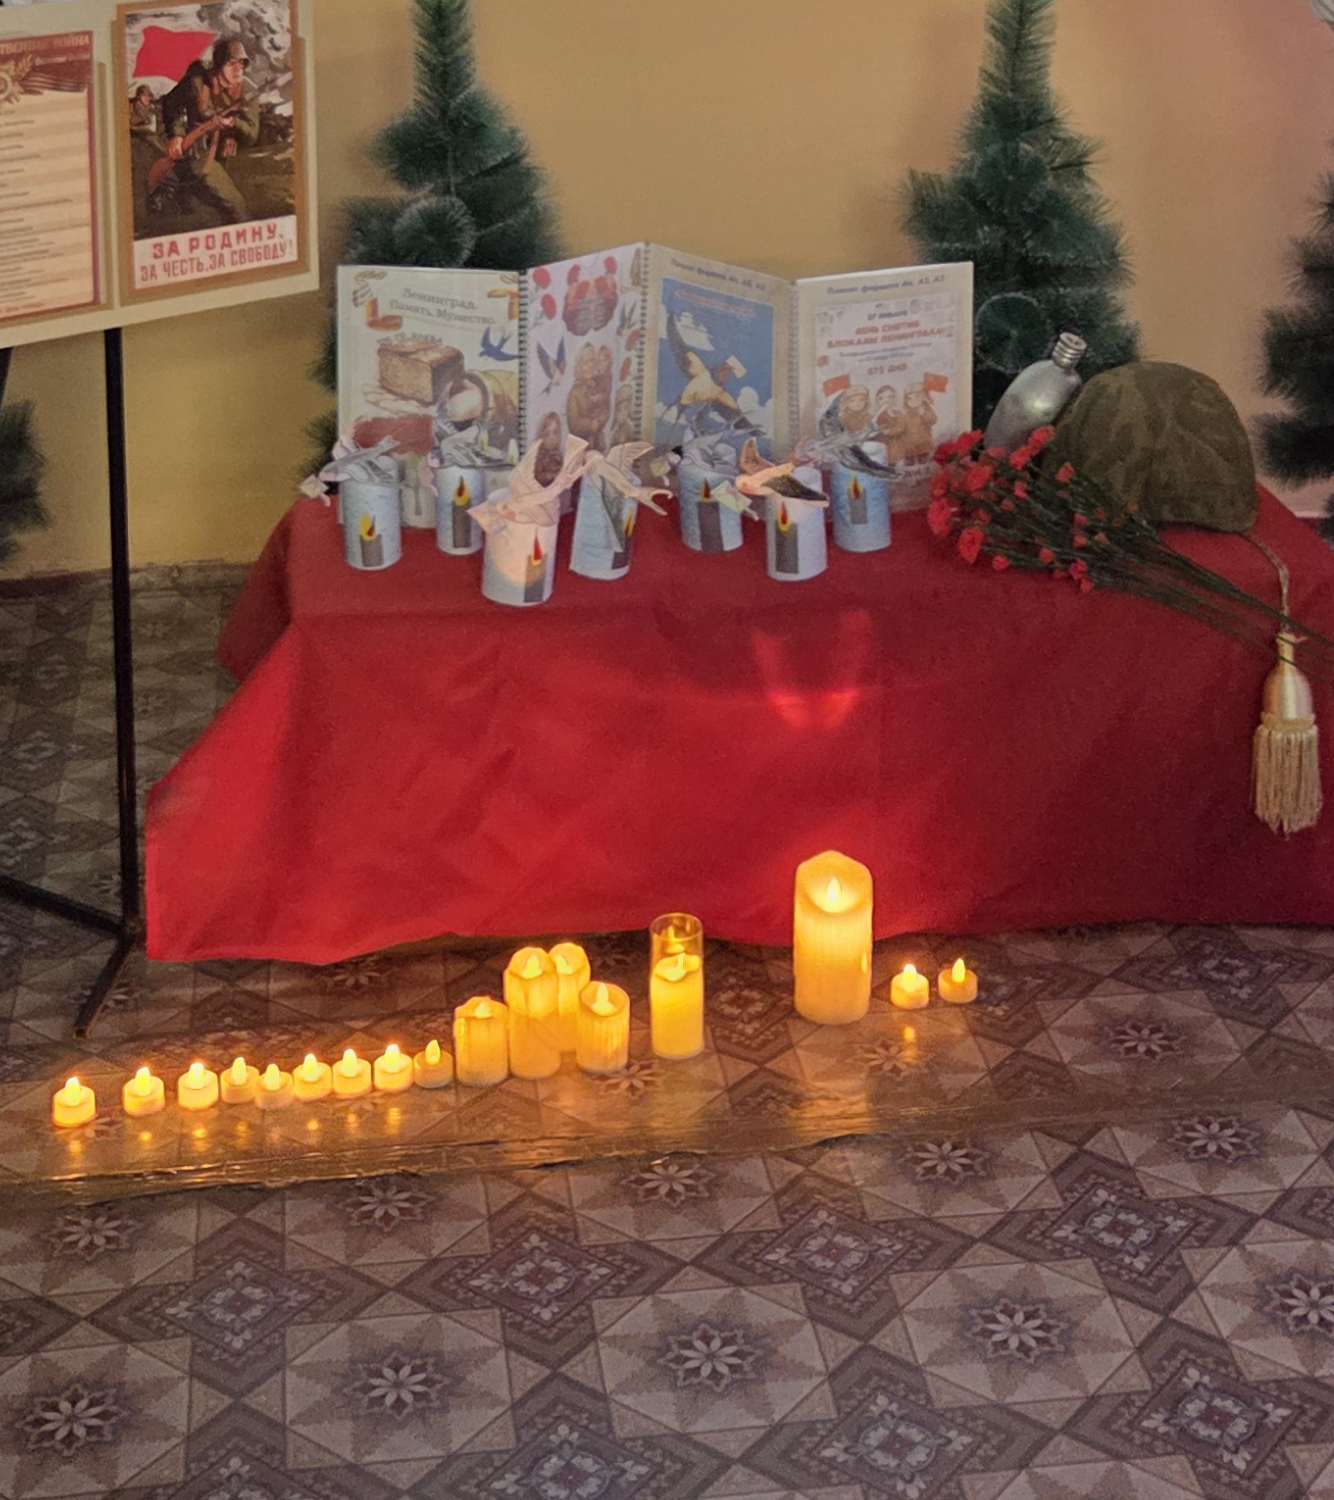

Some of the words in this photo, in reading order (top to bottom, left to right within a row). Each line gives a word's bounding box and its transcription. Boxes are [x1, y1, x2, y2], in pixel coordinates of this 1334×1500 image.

[140, 264, 158, 282] ЗА
[209, 253, 226, 271] ЗА
[230, 239, 294, 267] СВОБОДУ!
[152, 240, 180, 260] ЗА
[188, 223, 284, 253] РОДИНУ,
